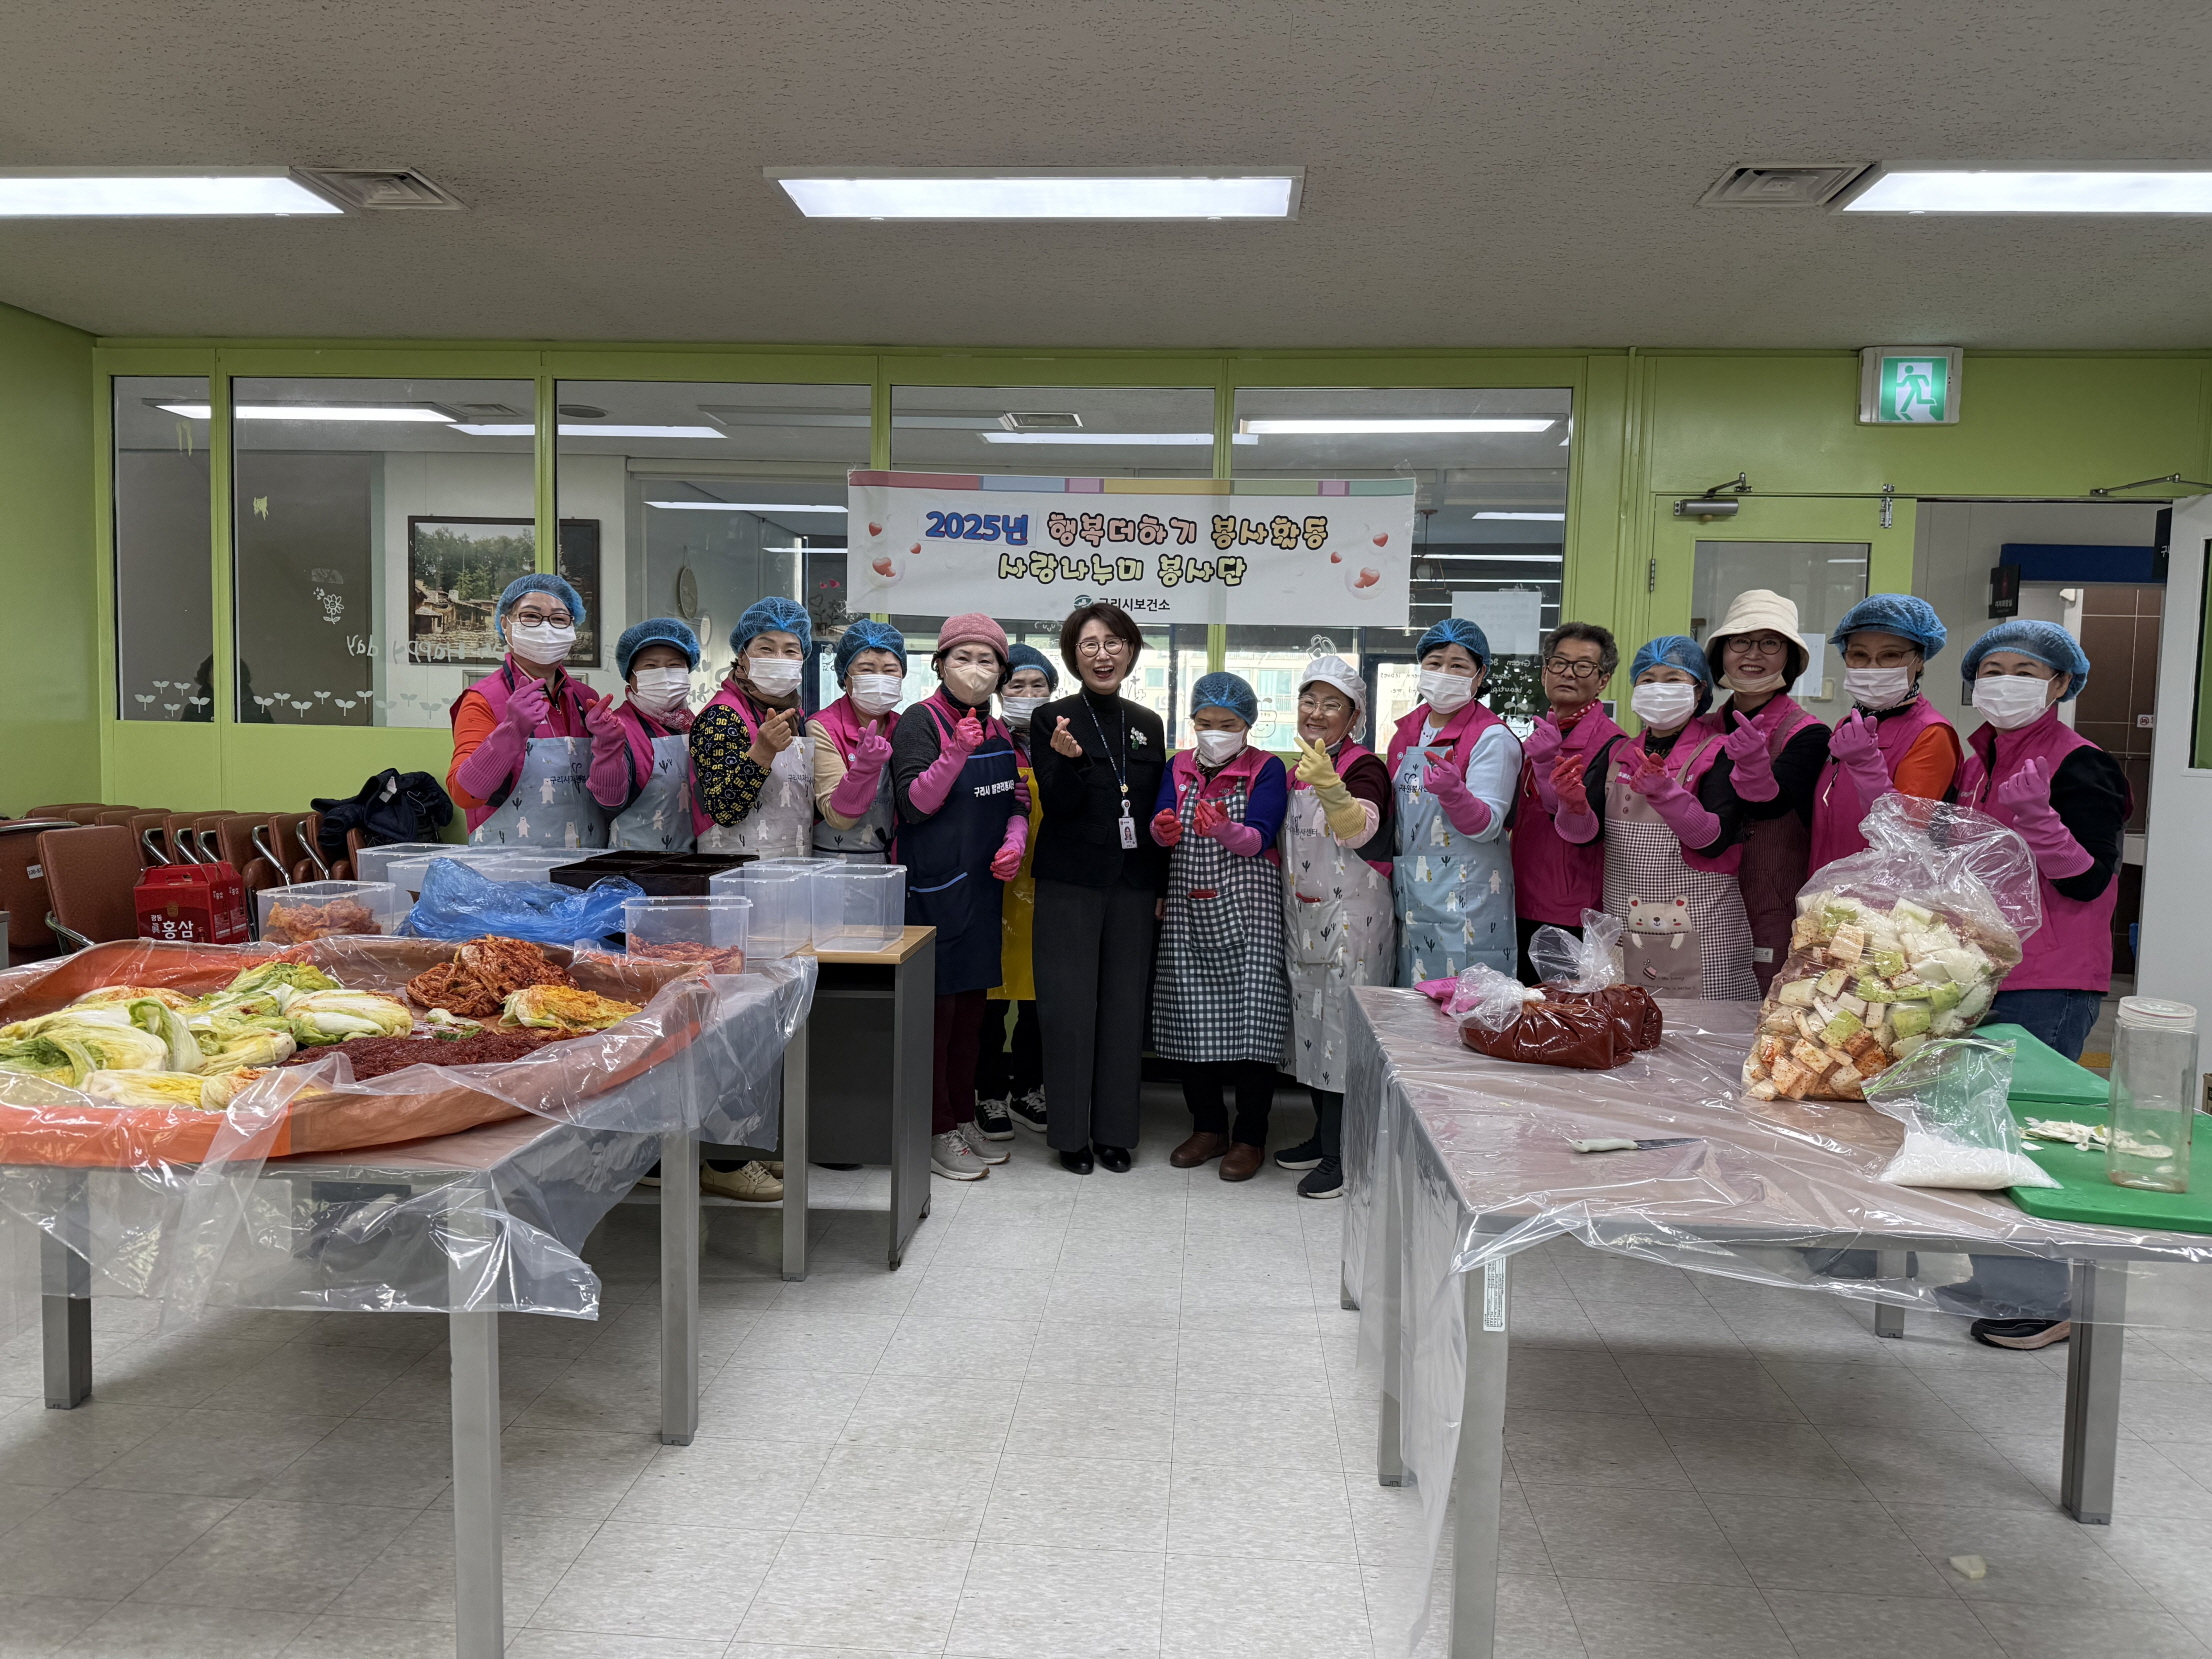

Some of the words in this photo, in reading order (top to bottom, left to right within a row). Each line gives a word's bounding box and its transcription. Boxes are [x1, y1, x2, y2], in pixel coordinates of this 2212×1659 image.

[926, 511, 1029, 546] 2025년
[1047, 512, 1197, 548] 행복더하기
[1211, 514, 1329, 550] 봉사활동
[998, 551, 1144, 587] 사랑나누미
[1157, 553, 1247, 588] 봉사단
[162, 920, 194, 939] 홍삼
